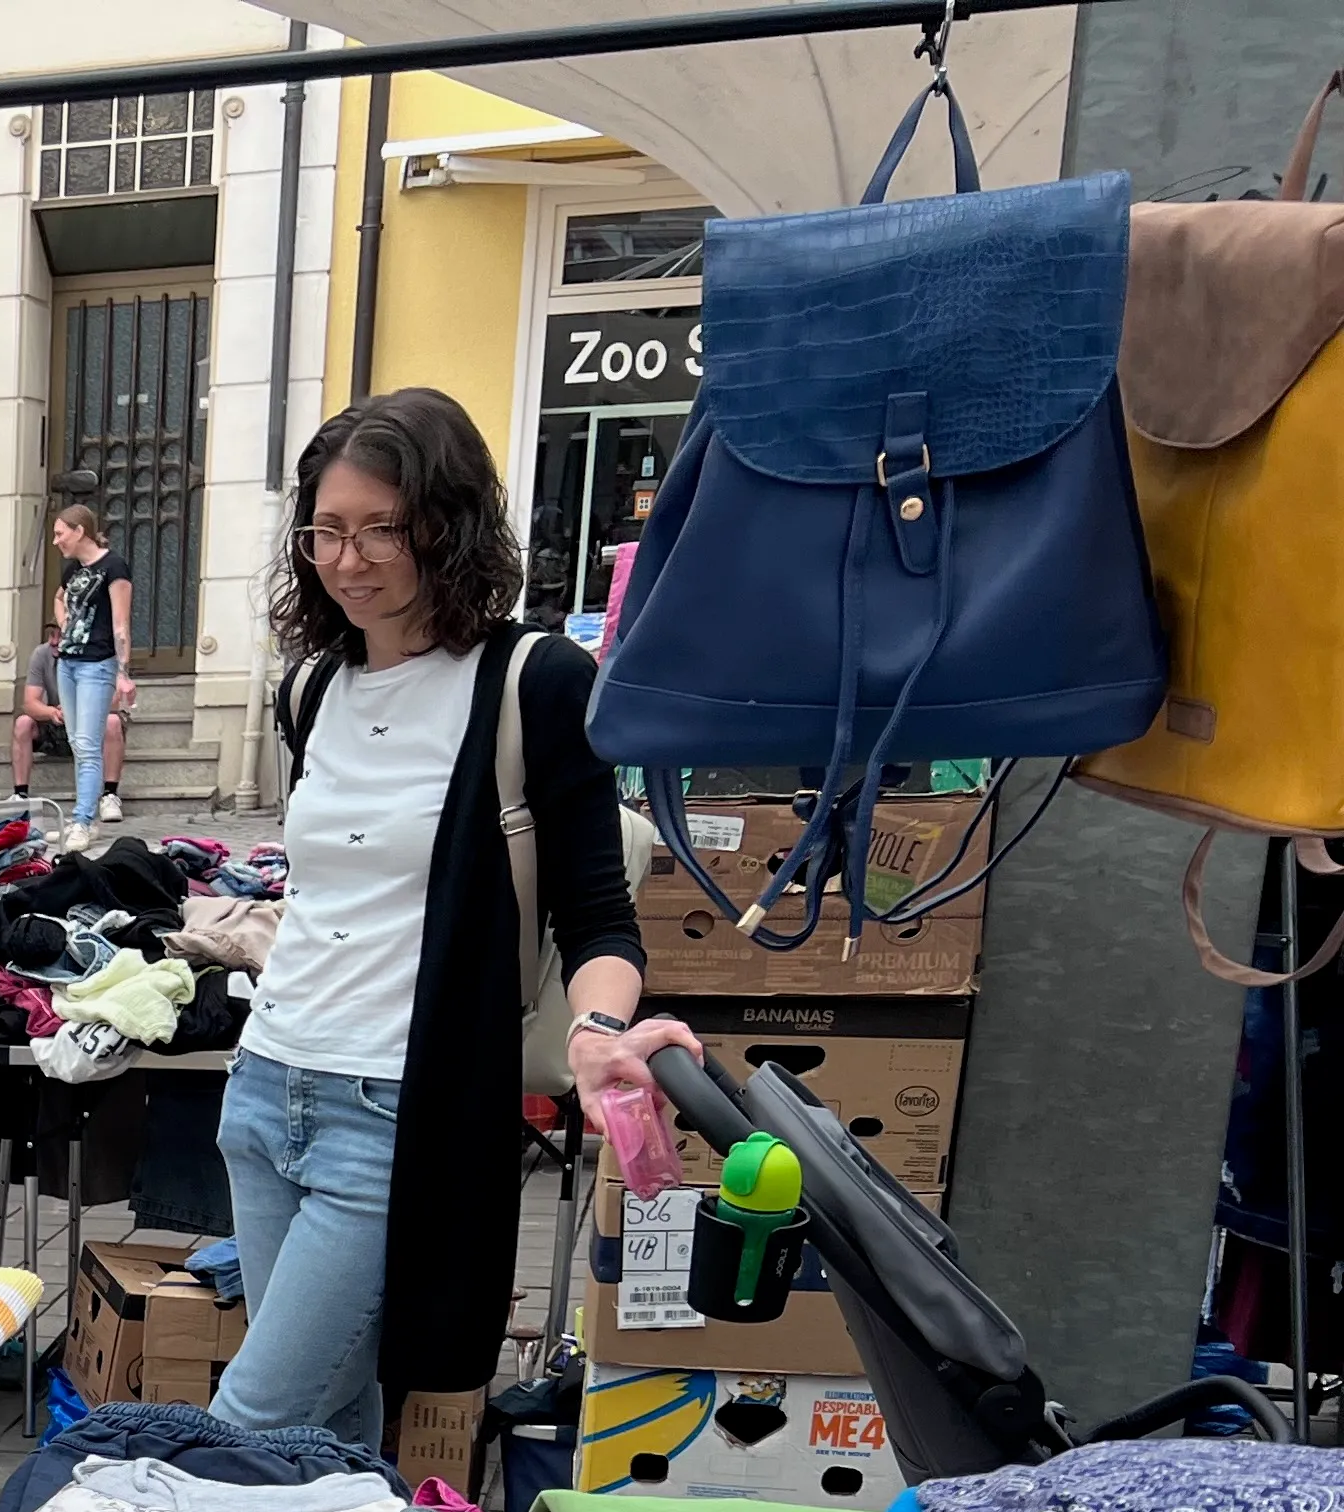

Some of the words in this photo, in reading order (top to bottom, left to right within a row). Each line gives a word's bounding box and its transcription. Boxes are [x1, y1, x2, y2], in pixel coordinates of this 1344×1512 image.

[564, 329, 668, 385] Zoo
[857, 952, 961, 971] PREMIUM
[855, 970, 882, 985] BIO
[885, 969, 961, 985] BANANEN
[743, 1007, 836, 1024] BANANAS
[794, 1022, 833, 1032] ORGANIC
[898, 1091, 937, 1109] favorita
[626, 1195, 673, 1225] 526
[627, 1236, 659, 1262] 48
